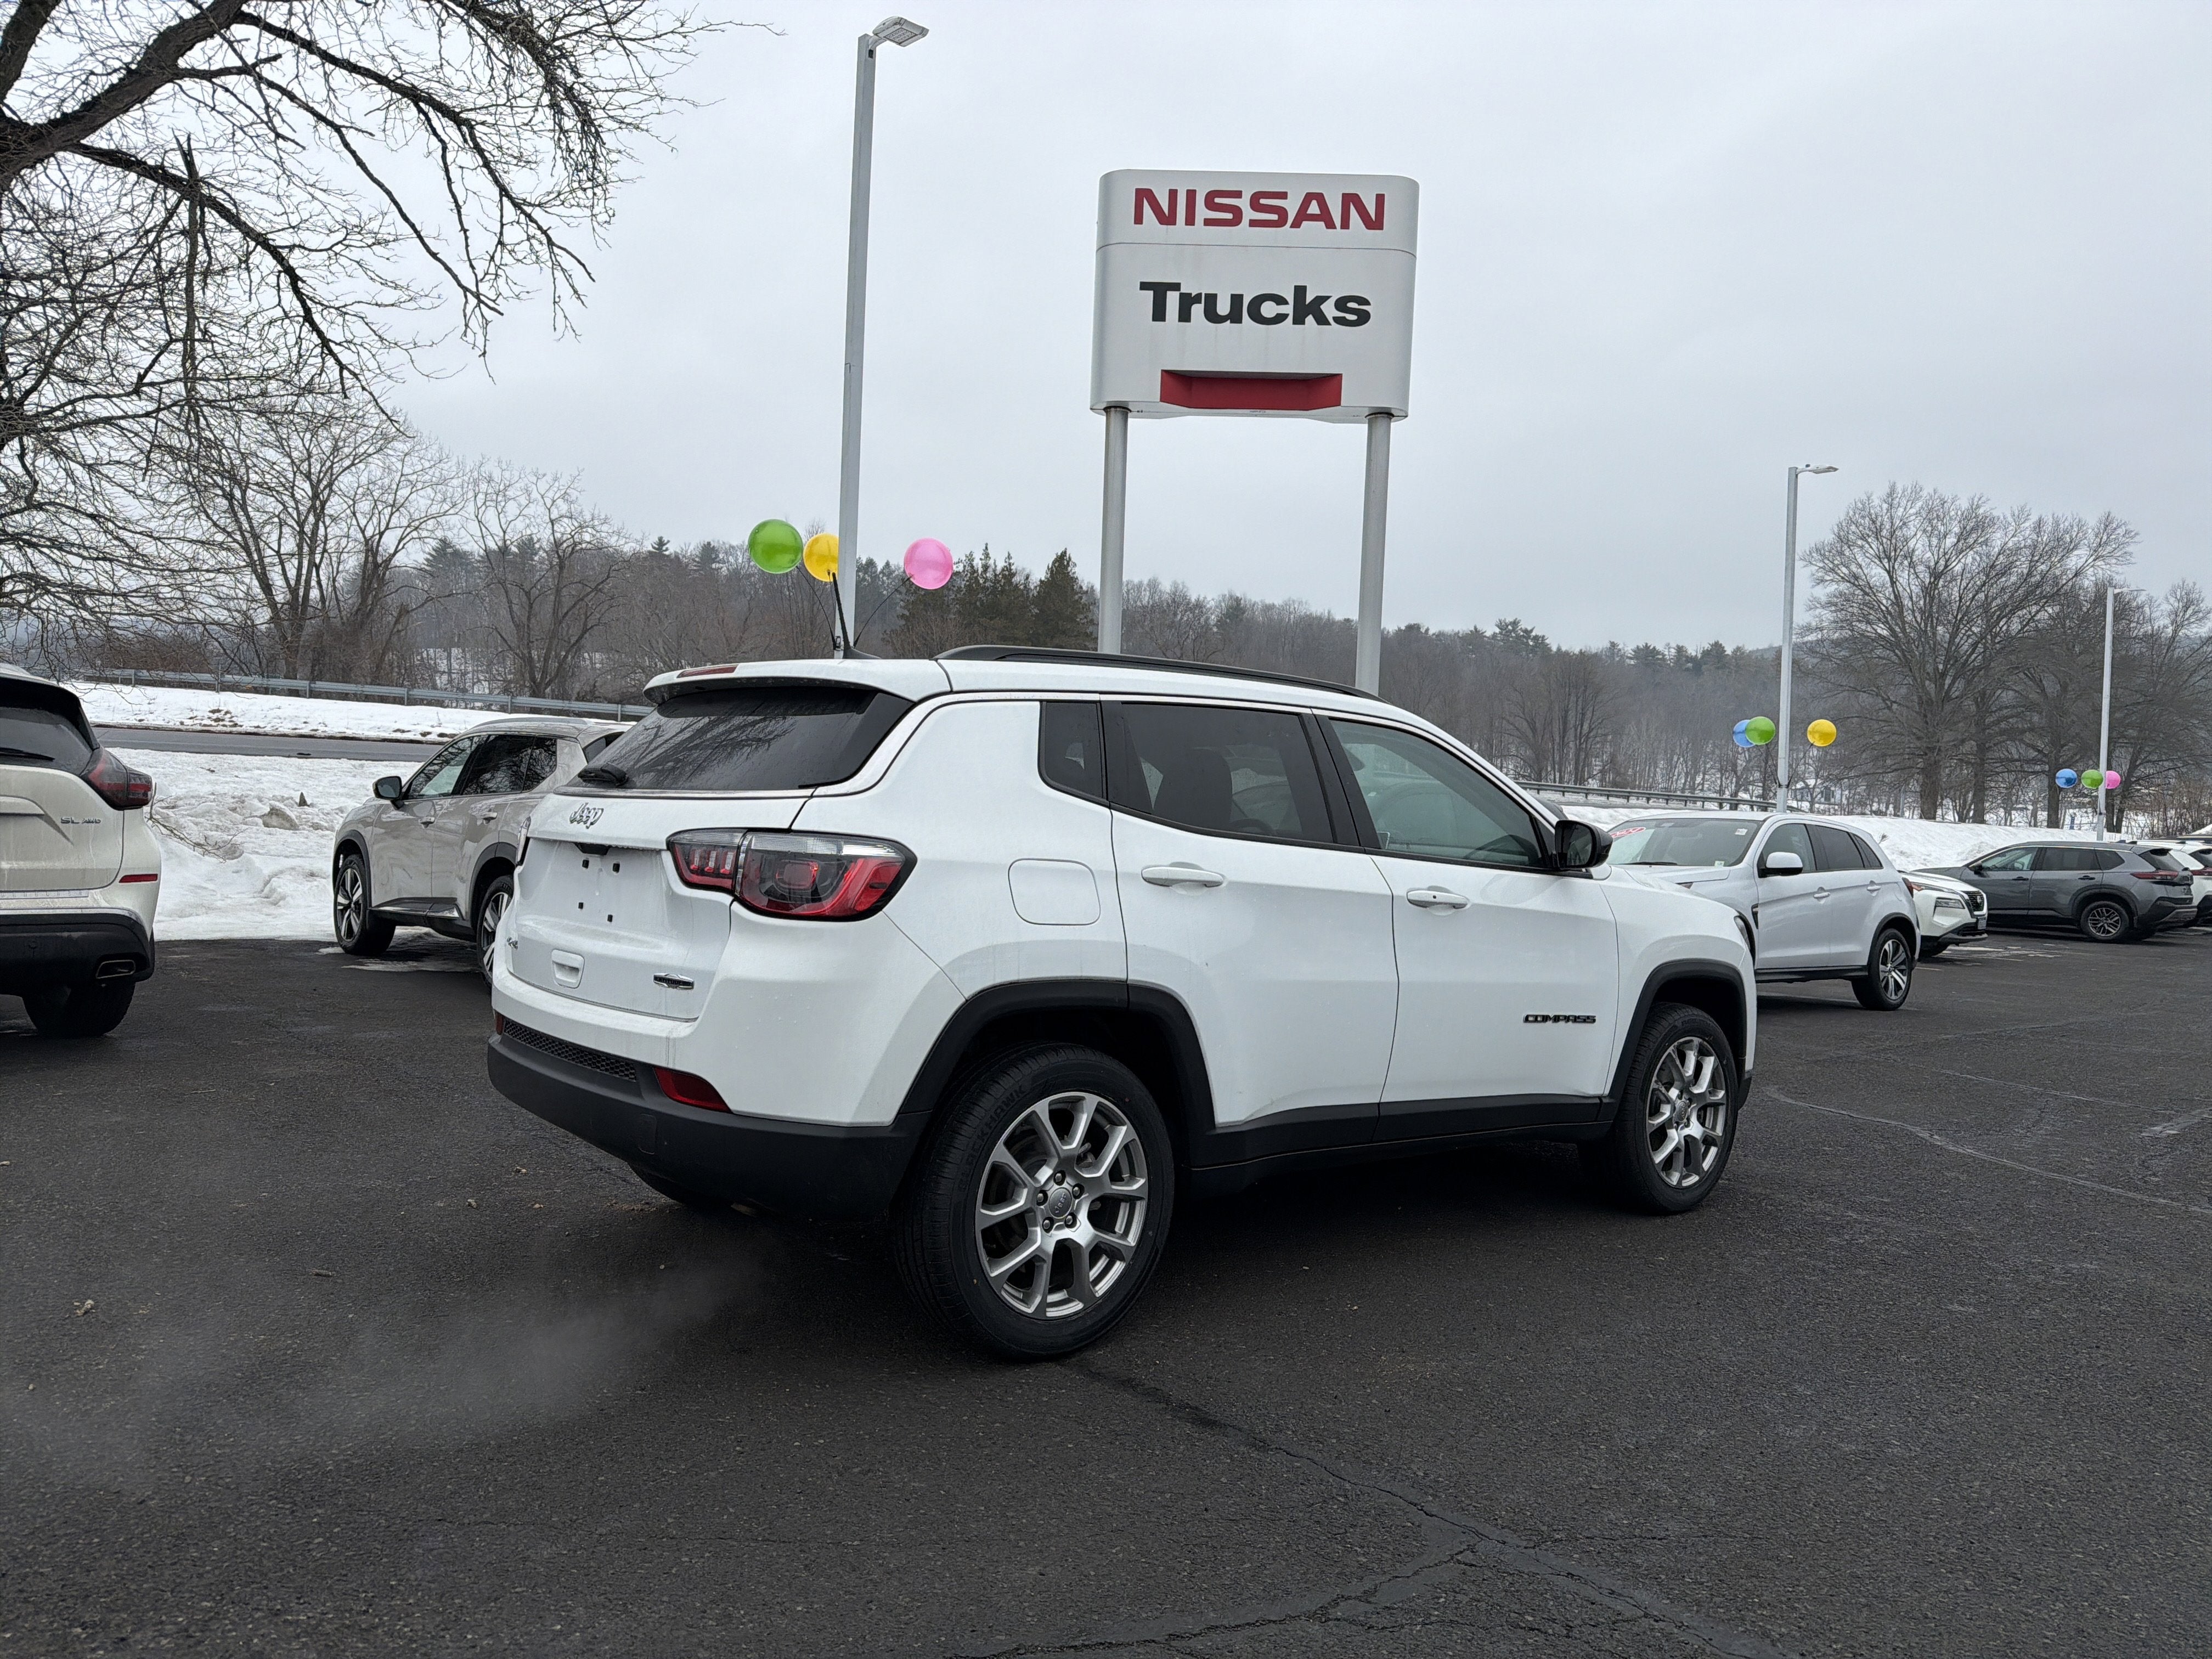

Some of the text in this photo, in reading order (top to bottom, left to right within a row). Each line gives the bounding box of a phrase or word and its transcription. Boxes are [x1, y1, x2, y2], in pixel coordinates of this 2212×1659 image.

[1133, 188, 1386, 230] NISSAN
[1139, 281, 1372, 328] Trucks
[569, 802, 604, 829] Jeep
[1523, 1014, 1596, 1024] COMPASS
